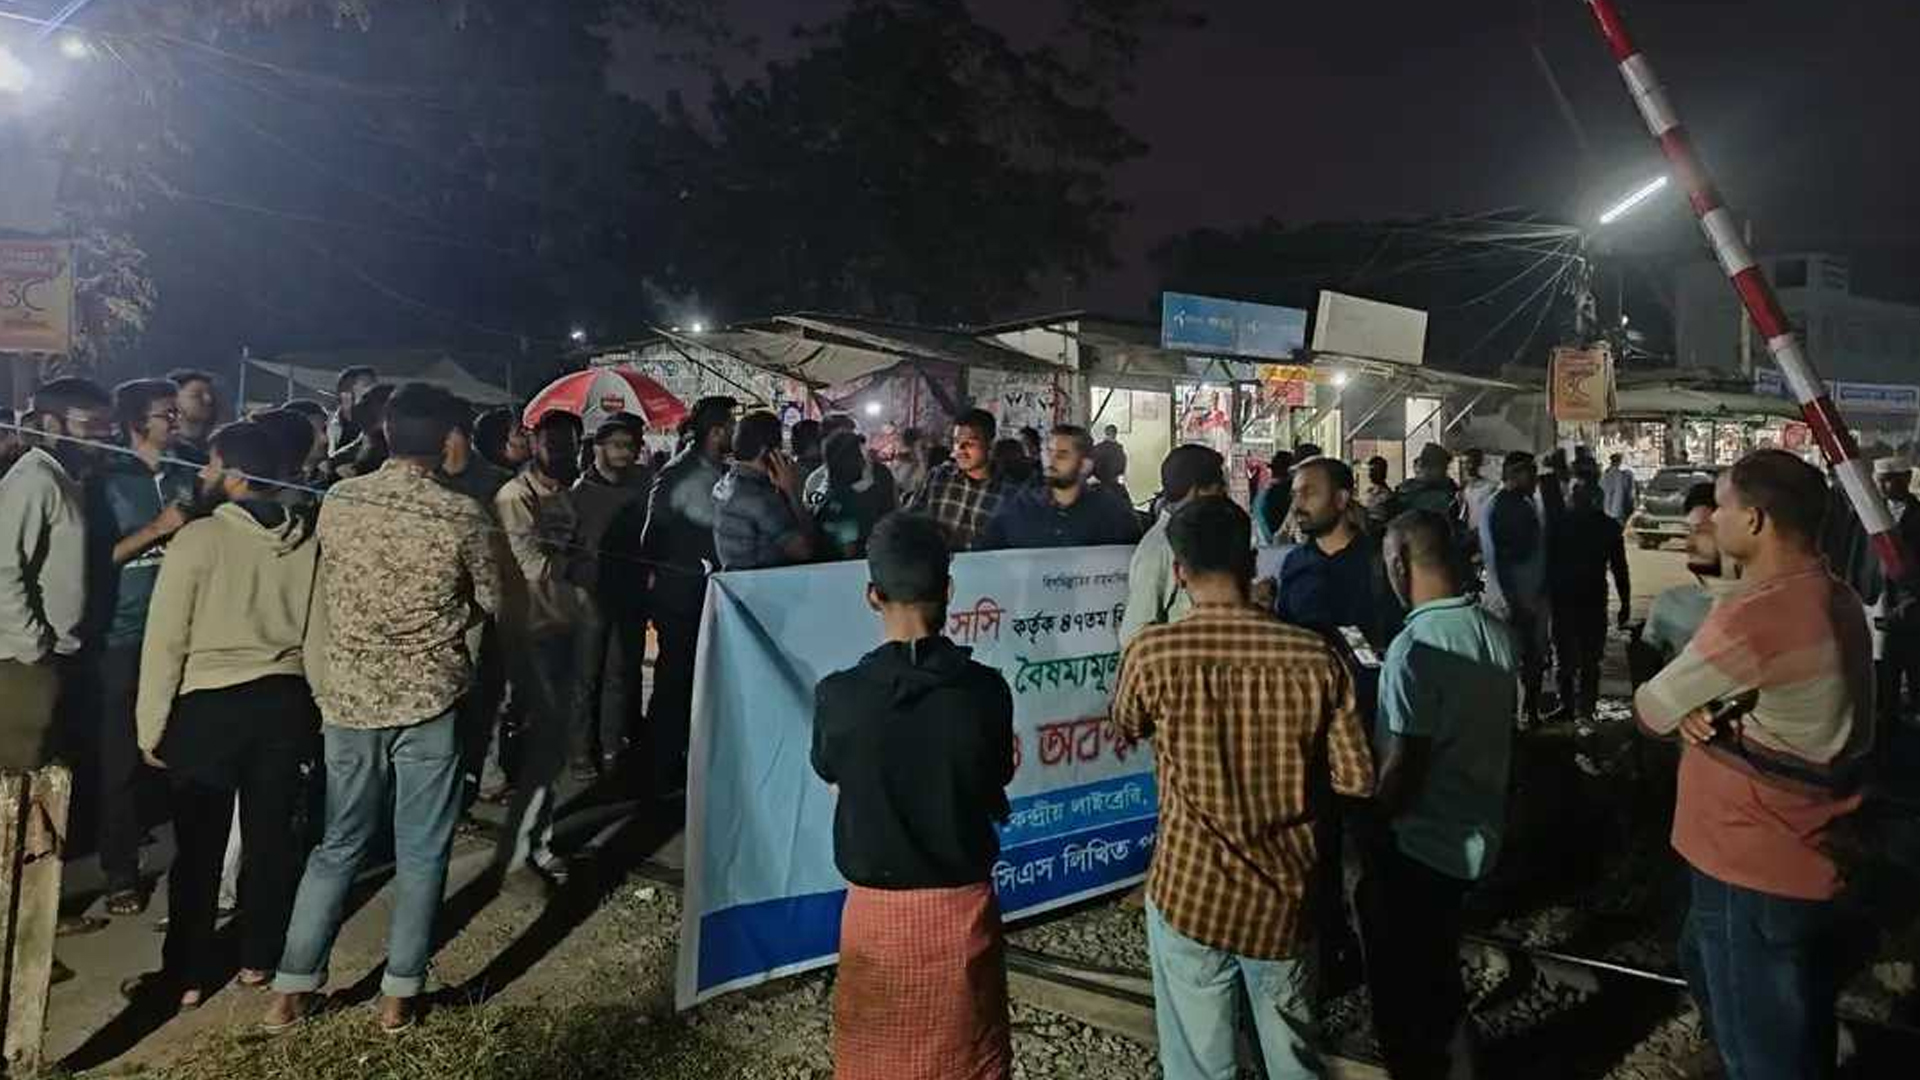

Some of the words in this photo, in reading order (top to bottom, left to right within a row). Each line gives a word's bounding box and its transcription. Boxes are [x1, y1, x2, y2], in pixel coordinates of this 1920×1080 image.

[1012, 611, 1057, 644] কর্তৃক
[1059, 610, 1108, 634] ৪৭তম
[1063, 839, 1131, 876] লিখিত
